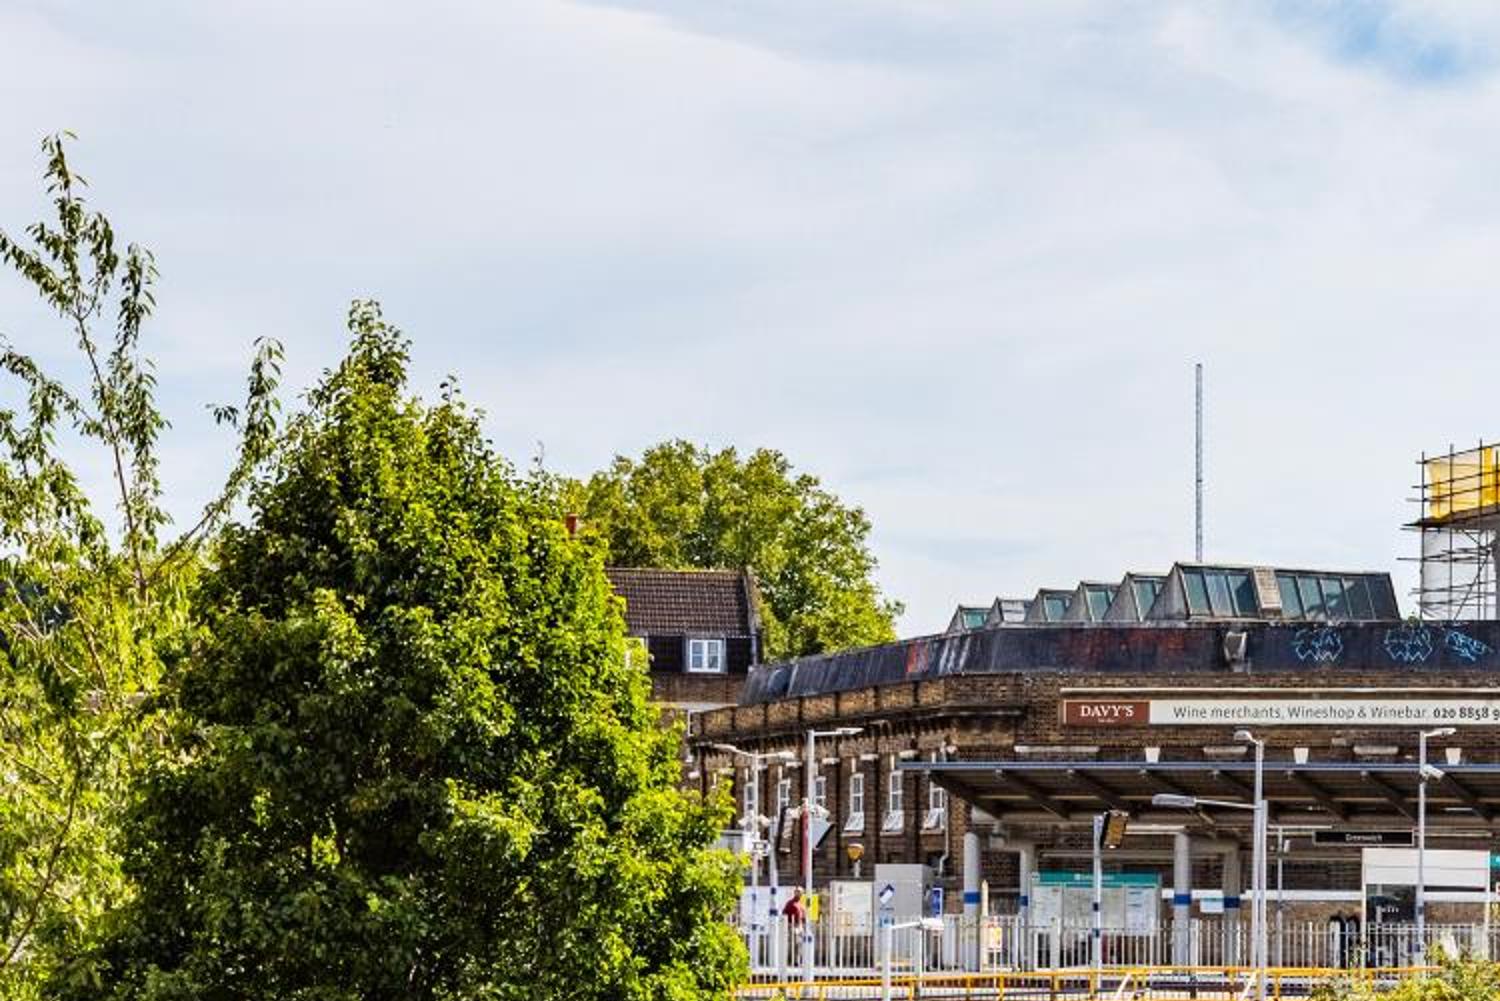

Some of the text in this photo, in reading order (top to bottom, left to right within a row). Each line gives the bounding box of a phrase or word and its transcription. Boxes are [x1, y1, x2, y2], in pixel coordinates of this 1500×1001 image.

[1080, 704, 1135, 717] DAVY'S
[1173, 706, 1207, 719] Wine
[1288, 705, 1355, 720] Wineshop
[1357, 706, 1367, 719] &
[1433, 707, 1456, 719] 020
[1459, 706, 1489, 721] 8858
